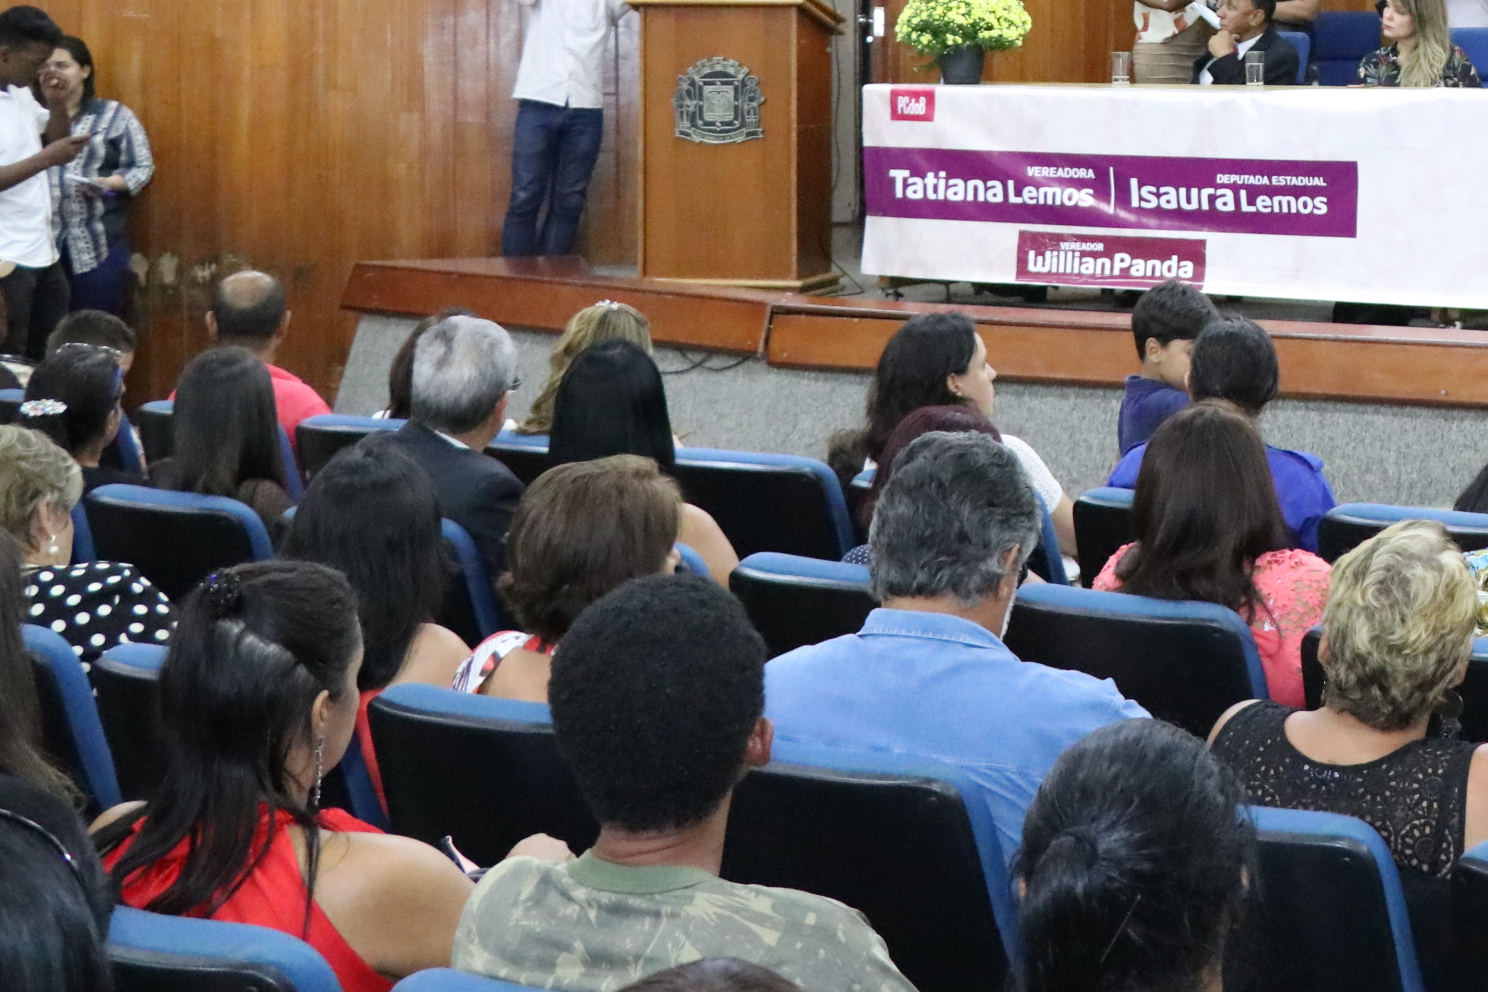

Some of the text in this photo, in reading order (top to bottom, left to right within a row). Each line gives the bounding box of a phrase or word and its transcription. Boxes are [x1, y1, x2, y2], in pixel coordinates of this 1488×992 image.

[897, 95, 927, 115] PCdoB
[1026, 166, 1095, 179] VEREADORA
[1216, 173, 1327, 186] DEPUTADA ESTADUAL
[889, 169, 1094, 207] Tatiana Lemos
[1129, 177, 1328, 215] Isaura Lemos
[1060, 241, 1104, 251] VEREADOR
